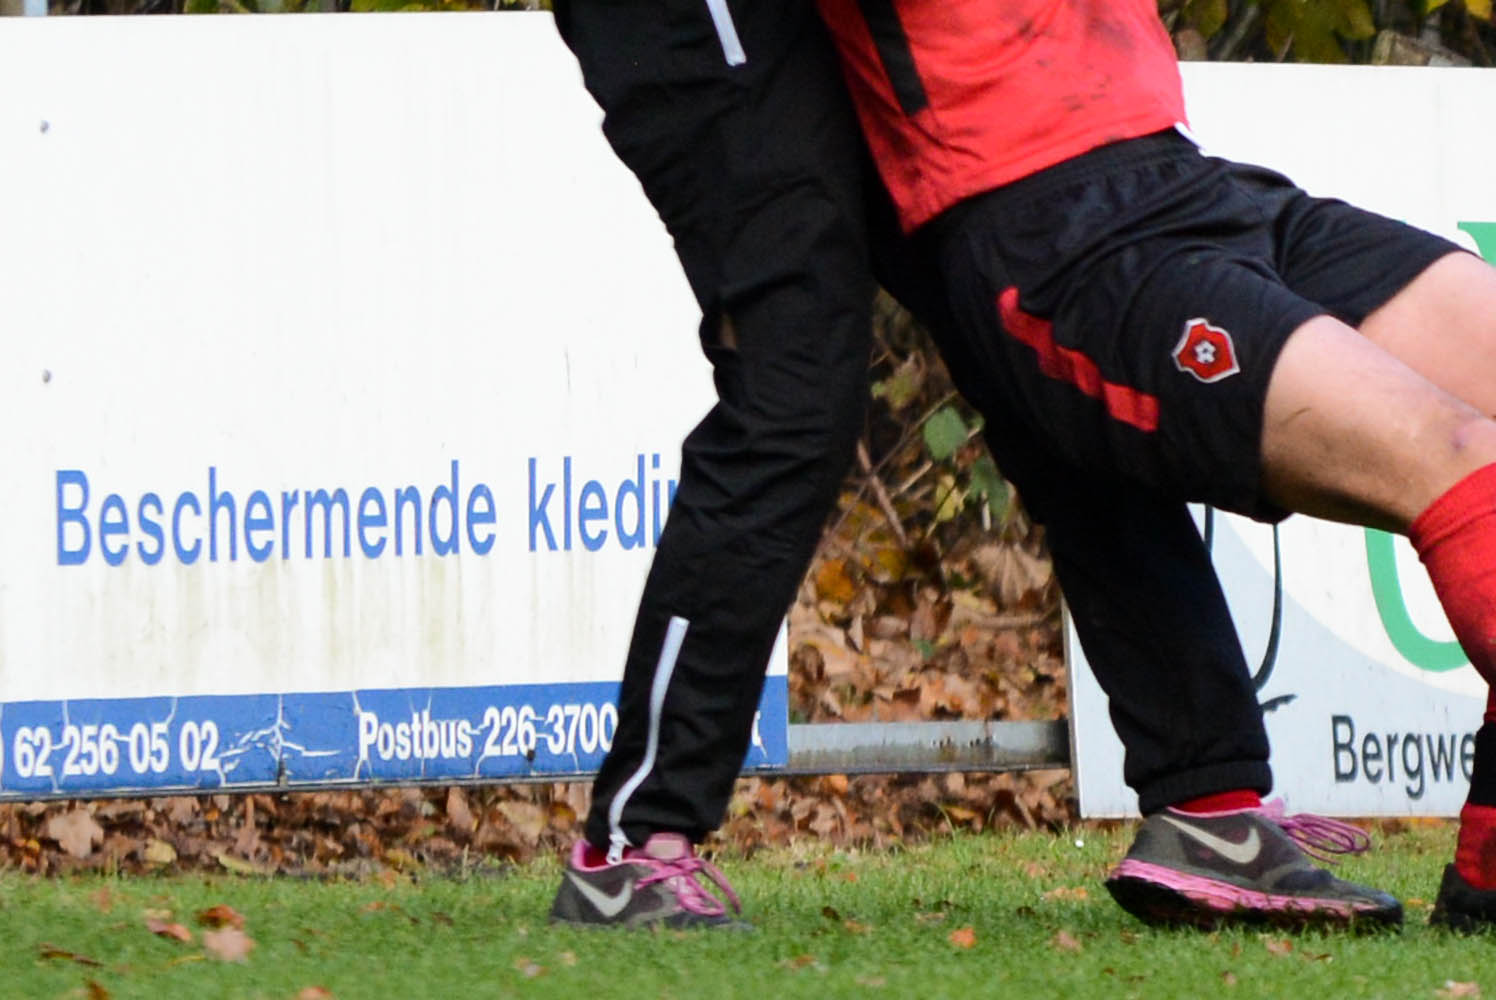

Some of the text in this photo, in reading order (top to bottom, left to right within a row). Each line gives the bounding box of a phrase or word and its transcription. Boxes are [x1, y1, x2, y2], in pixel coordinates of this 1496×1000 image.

[56, 453, 677, 566] Beschermende kledi
[14, 726, 52, 778] 62
[62, 724, 119, 775] 256
[129, 722, 169, 773] 05
[179, 720, 220, 772] 02
[358, 711, 472, 760] Postbus
[1332, 715, 1477, 799] Bergwe
